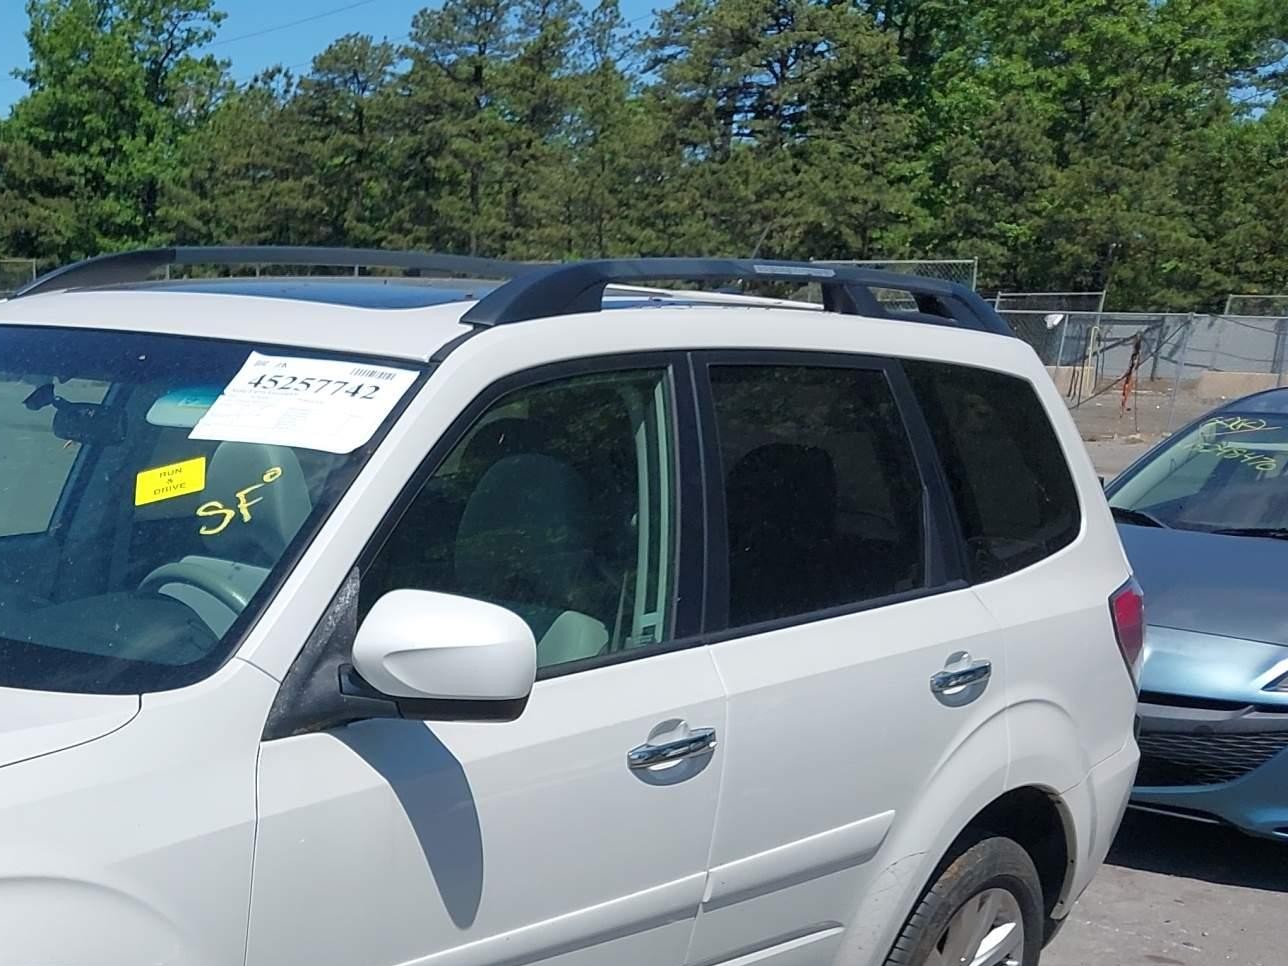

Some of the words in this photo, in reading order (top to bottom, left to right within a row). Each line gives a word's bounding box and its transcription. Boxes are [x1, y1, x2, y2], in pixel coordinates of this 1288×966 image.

[248, 373, 381, 400] 45257742
[159, 467, 183, 479] RUN
[153, 482, 187, 496] DRIVE
